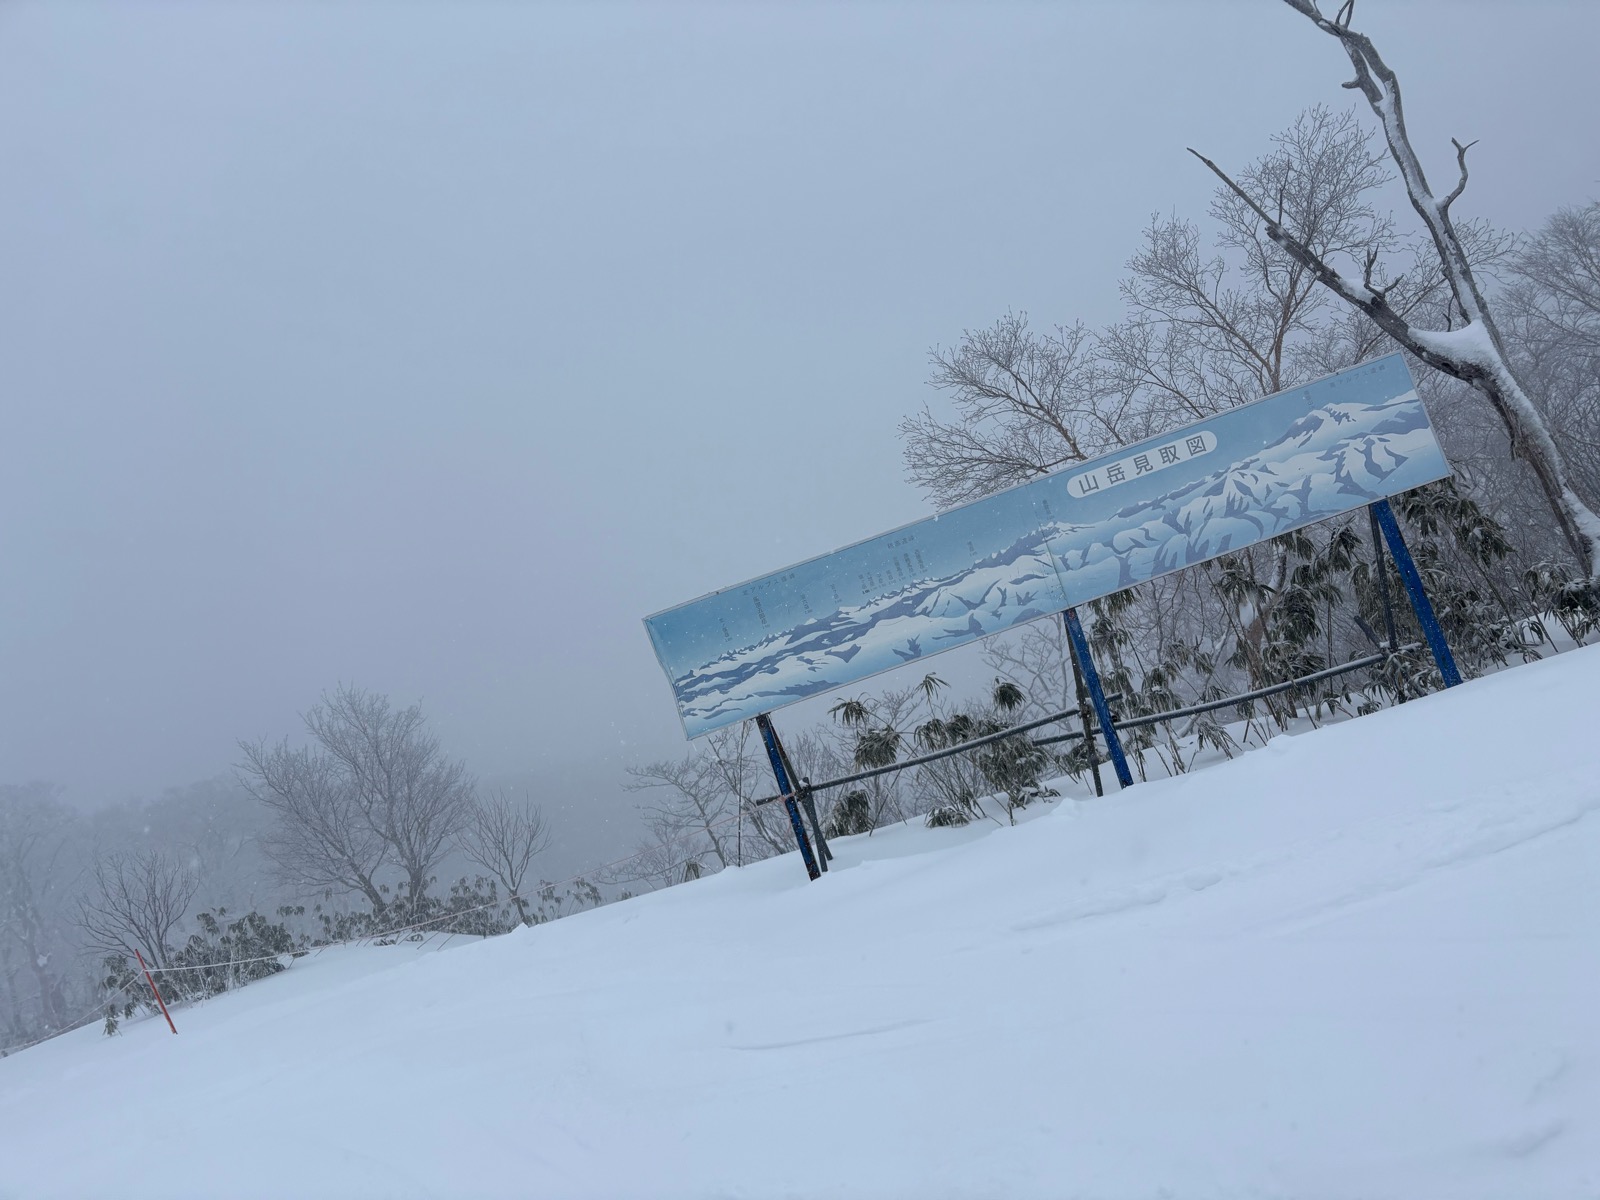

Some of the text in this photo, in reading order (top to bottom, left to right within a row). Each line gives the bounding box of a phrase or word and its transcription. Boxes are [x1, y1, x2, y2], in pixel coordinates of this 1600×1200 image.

[1078, 435, 1207, 495] 山岳見取図
